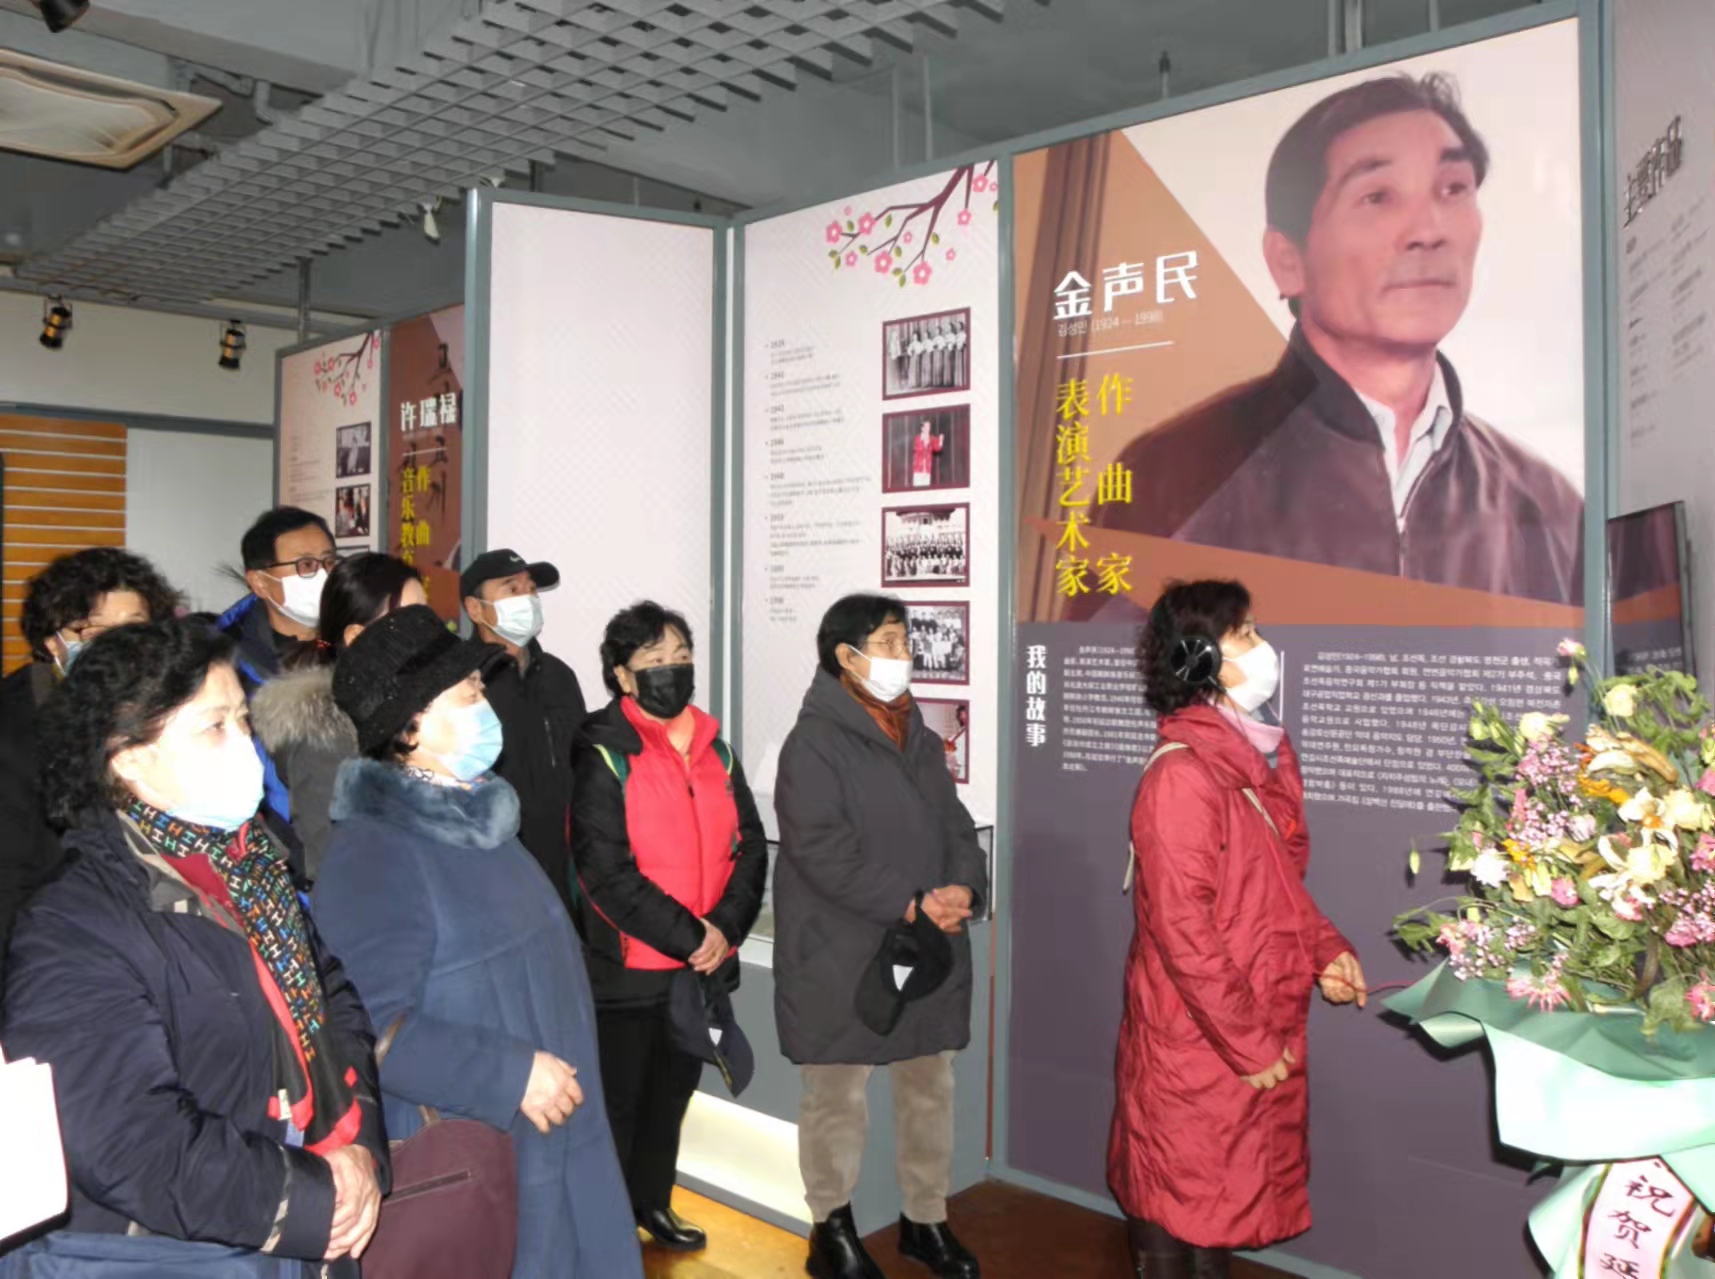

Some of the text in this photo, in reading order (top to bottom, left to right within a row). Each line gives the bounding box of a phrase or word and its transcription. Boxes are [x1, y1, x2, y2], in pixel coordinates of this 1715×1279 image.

[1053, 250, 1198, 320] 金声民
[1055, 376, 1091, 598] 表演艺术家
[1096, 372, 1133, 596] 作曲家
[1025, 644, 1047, 747] 我的故事
